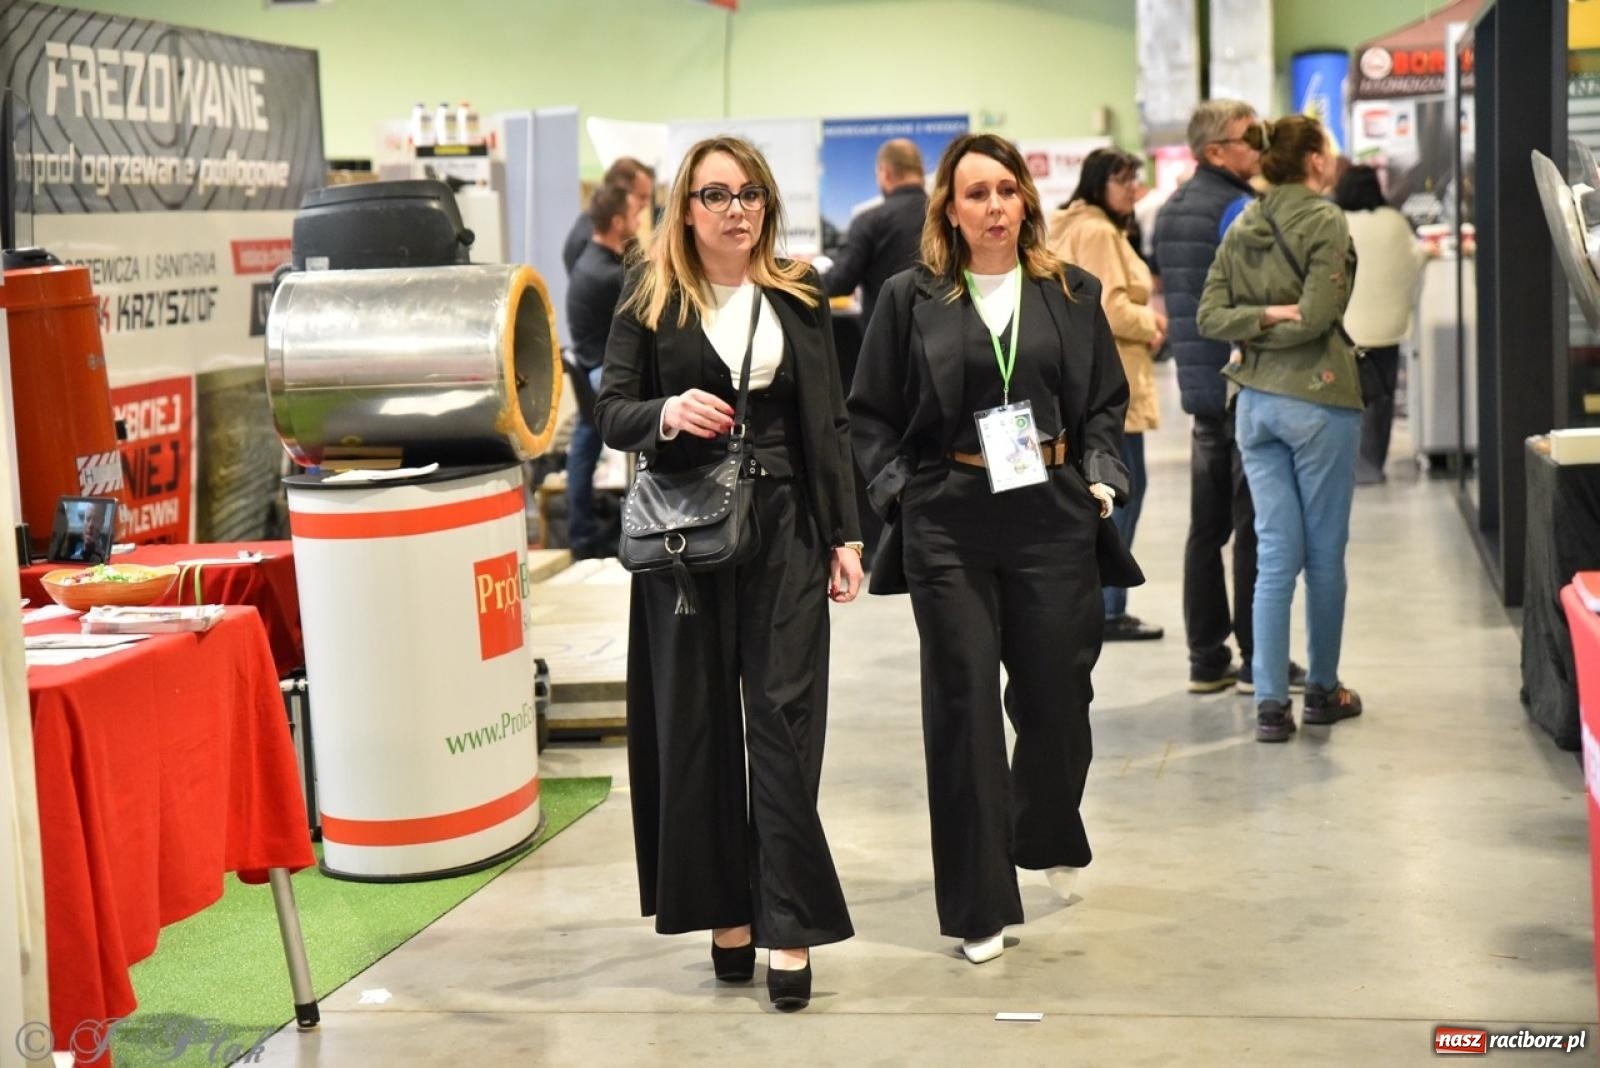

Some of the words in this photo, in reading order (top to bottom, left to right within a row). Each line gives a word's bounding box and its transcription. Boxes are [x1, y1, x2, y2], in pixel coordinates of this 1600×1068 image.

[45, 41, 270, 132] FREZOWANIE
[81, 153, 195, 196] ogrzewane
[116, 285, 219, 333] KRZYSZTOF
